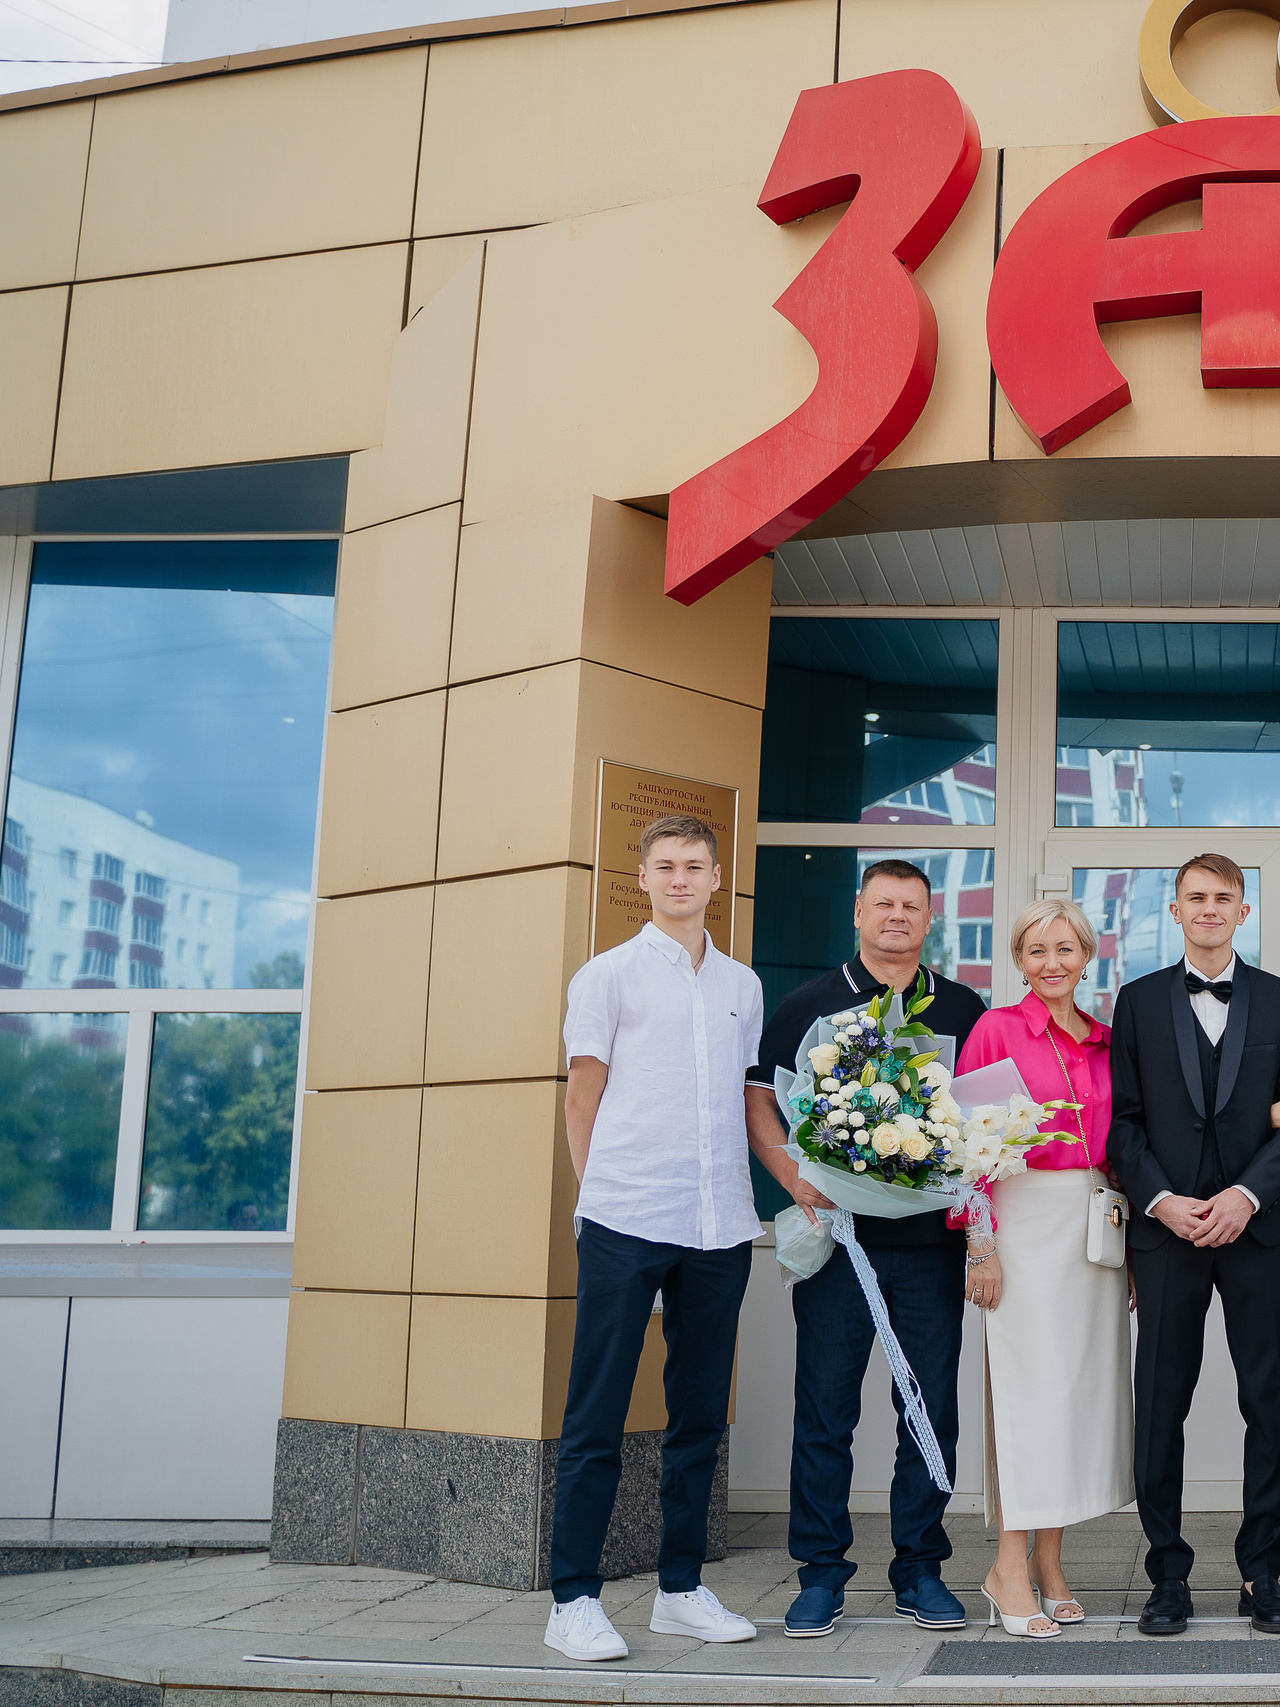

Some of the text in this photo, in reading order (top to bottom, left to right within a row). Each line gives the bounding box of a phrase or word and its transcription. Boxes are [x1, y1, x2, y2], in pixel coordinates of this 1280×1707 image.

[610, 802, 654, 817] ЮСТИЦИЯ
[610, 881, 649, 898] Государс
[627, 915, 639, 923] по
